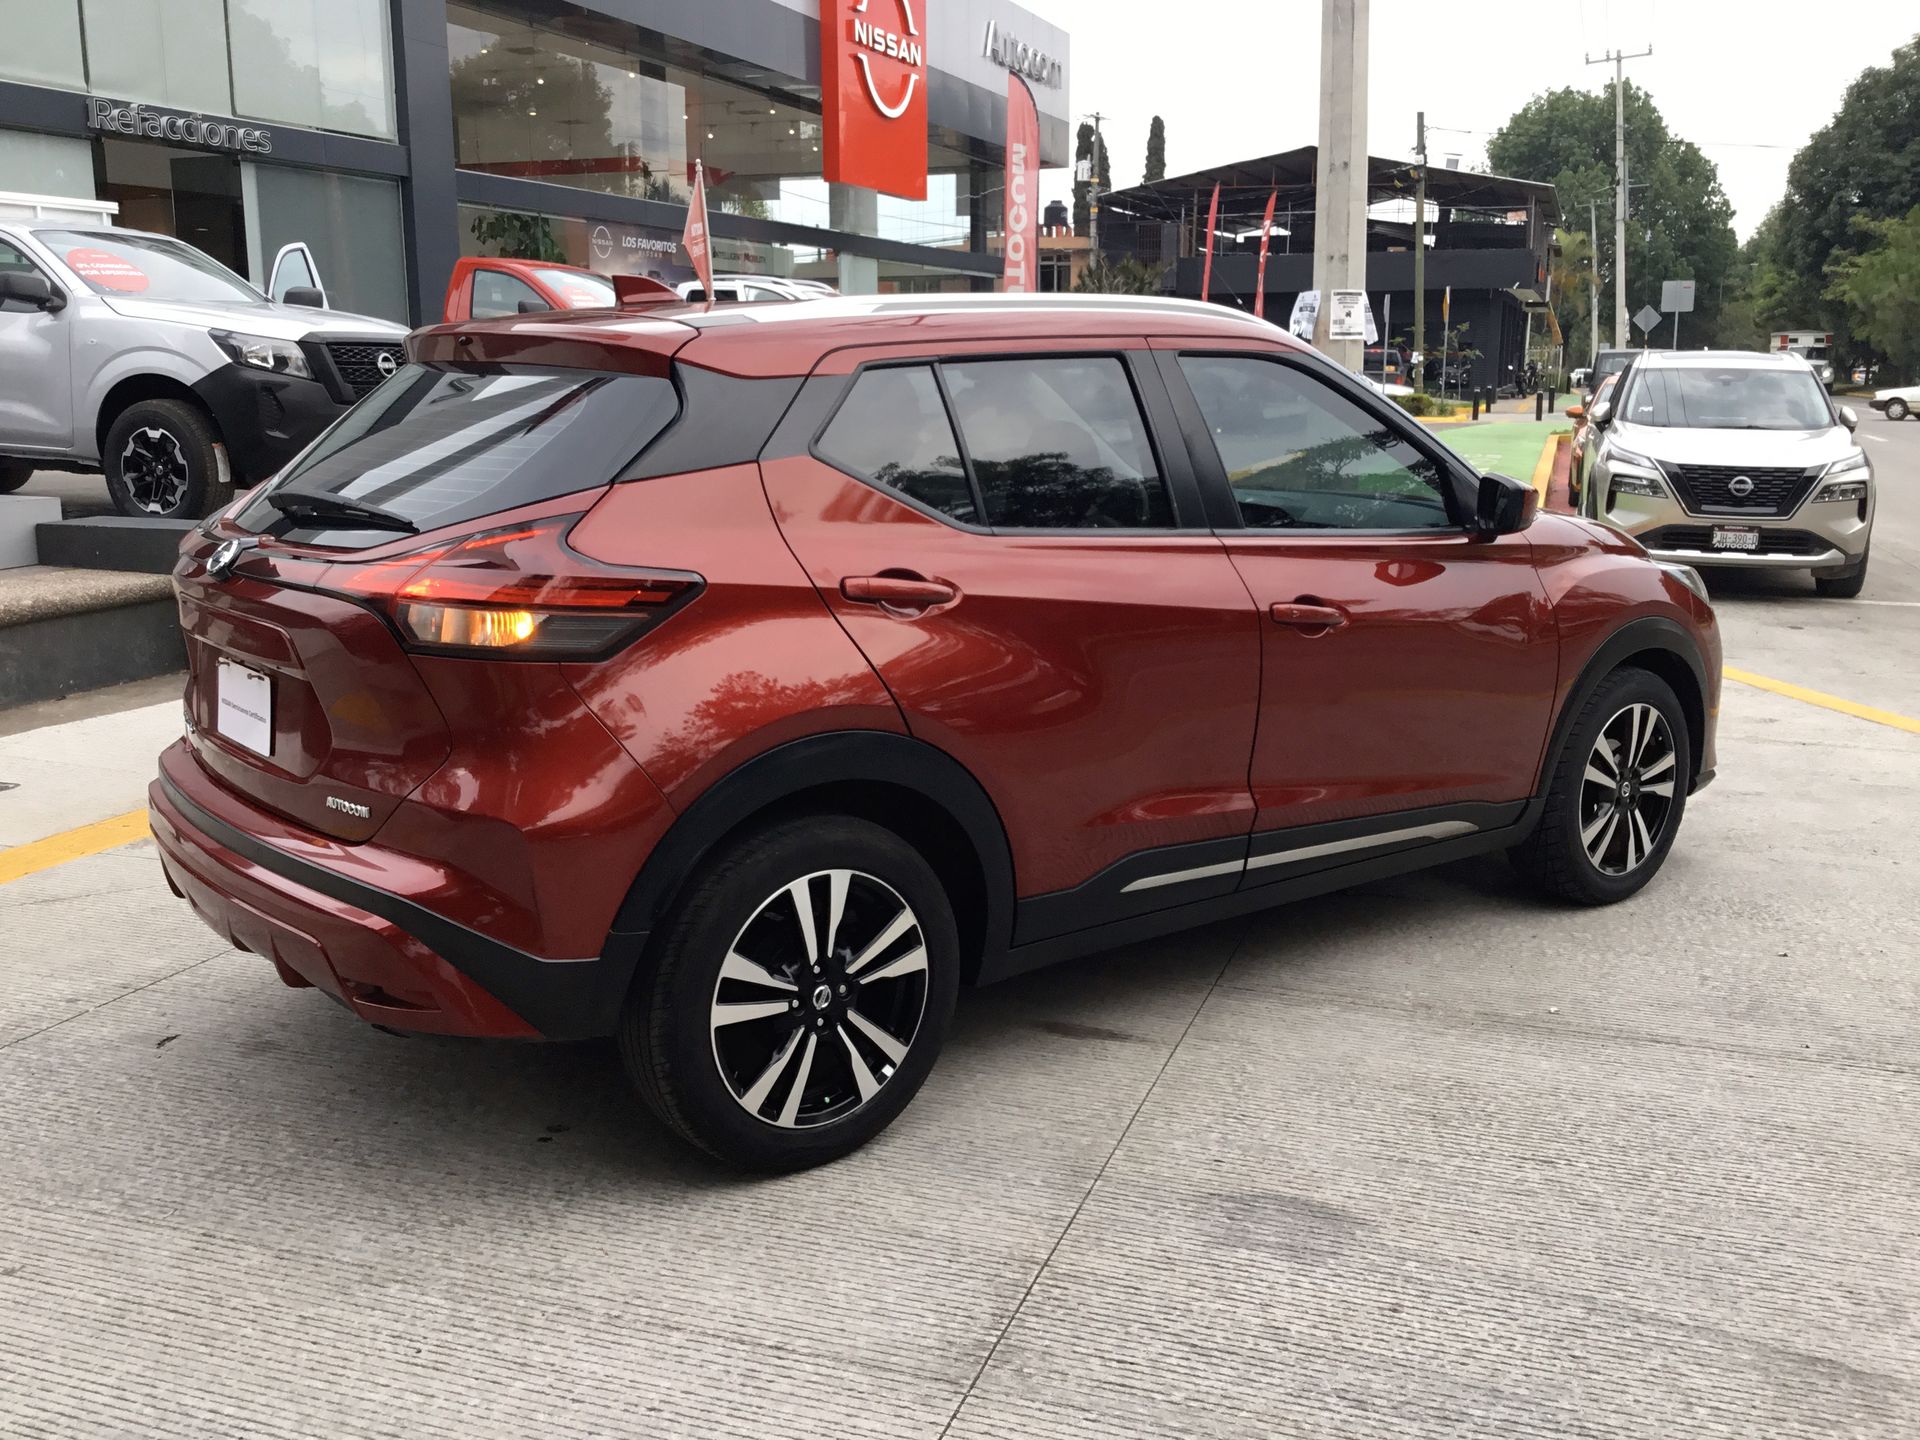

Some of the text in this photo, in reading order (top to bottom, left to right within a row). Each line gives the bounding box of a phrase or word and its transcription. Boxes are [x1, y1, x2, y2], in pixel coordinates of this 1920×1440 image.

[854, 18, 921, 67] NISSAN
[90, 97, 272, 153] Refacciones
[592, 237, 613, 246] NISSAN
[622, 235, 637, 249] LOS
[637, 238, 677, 254] FAVORITOS
[1713, 542, 1756, 551] AUTOCOM
[326, 796, 370, 818] AUTOCOM
